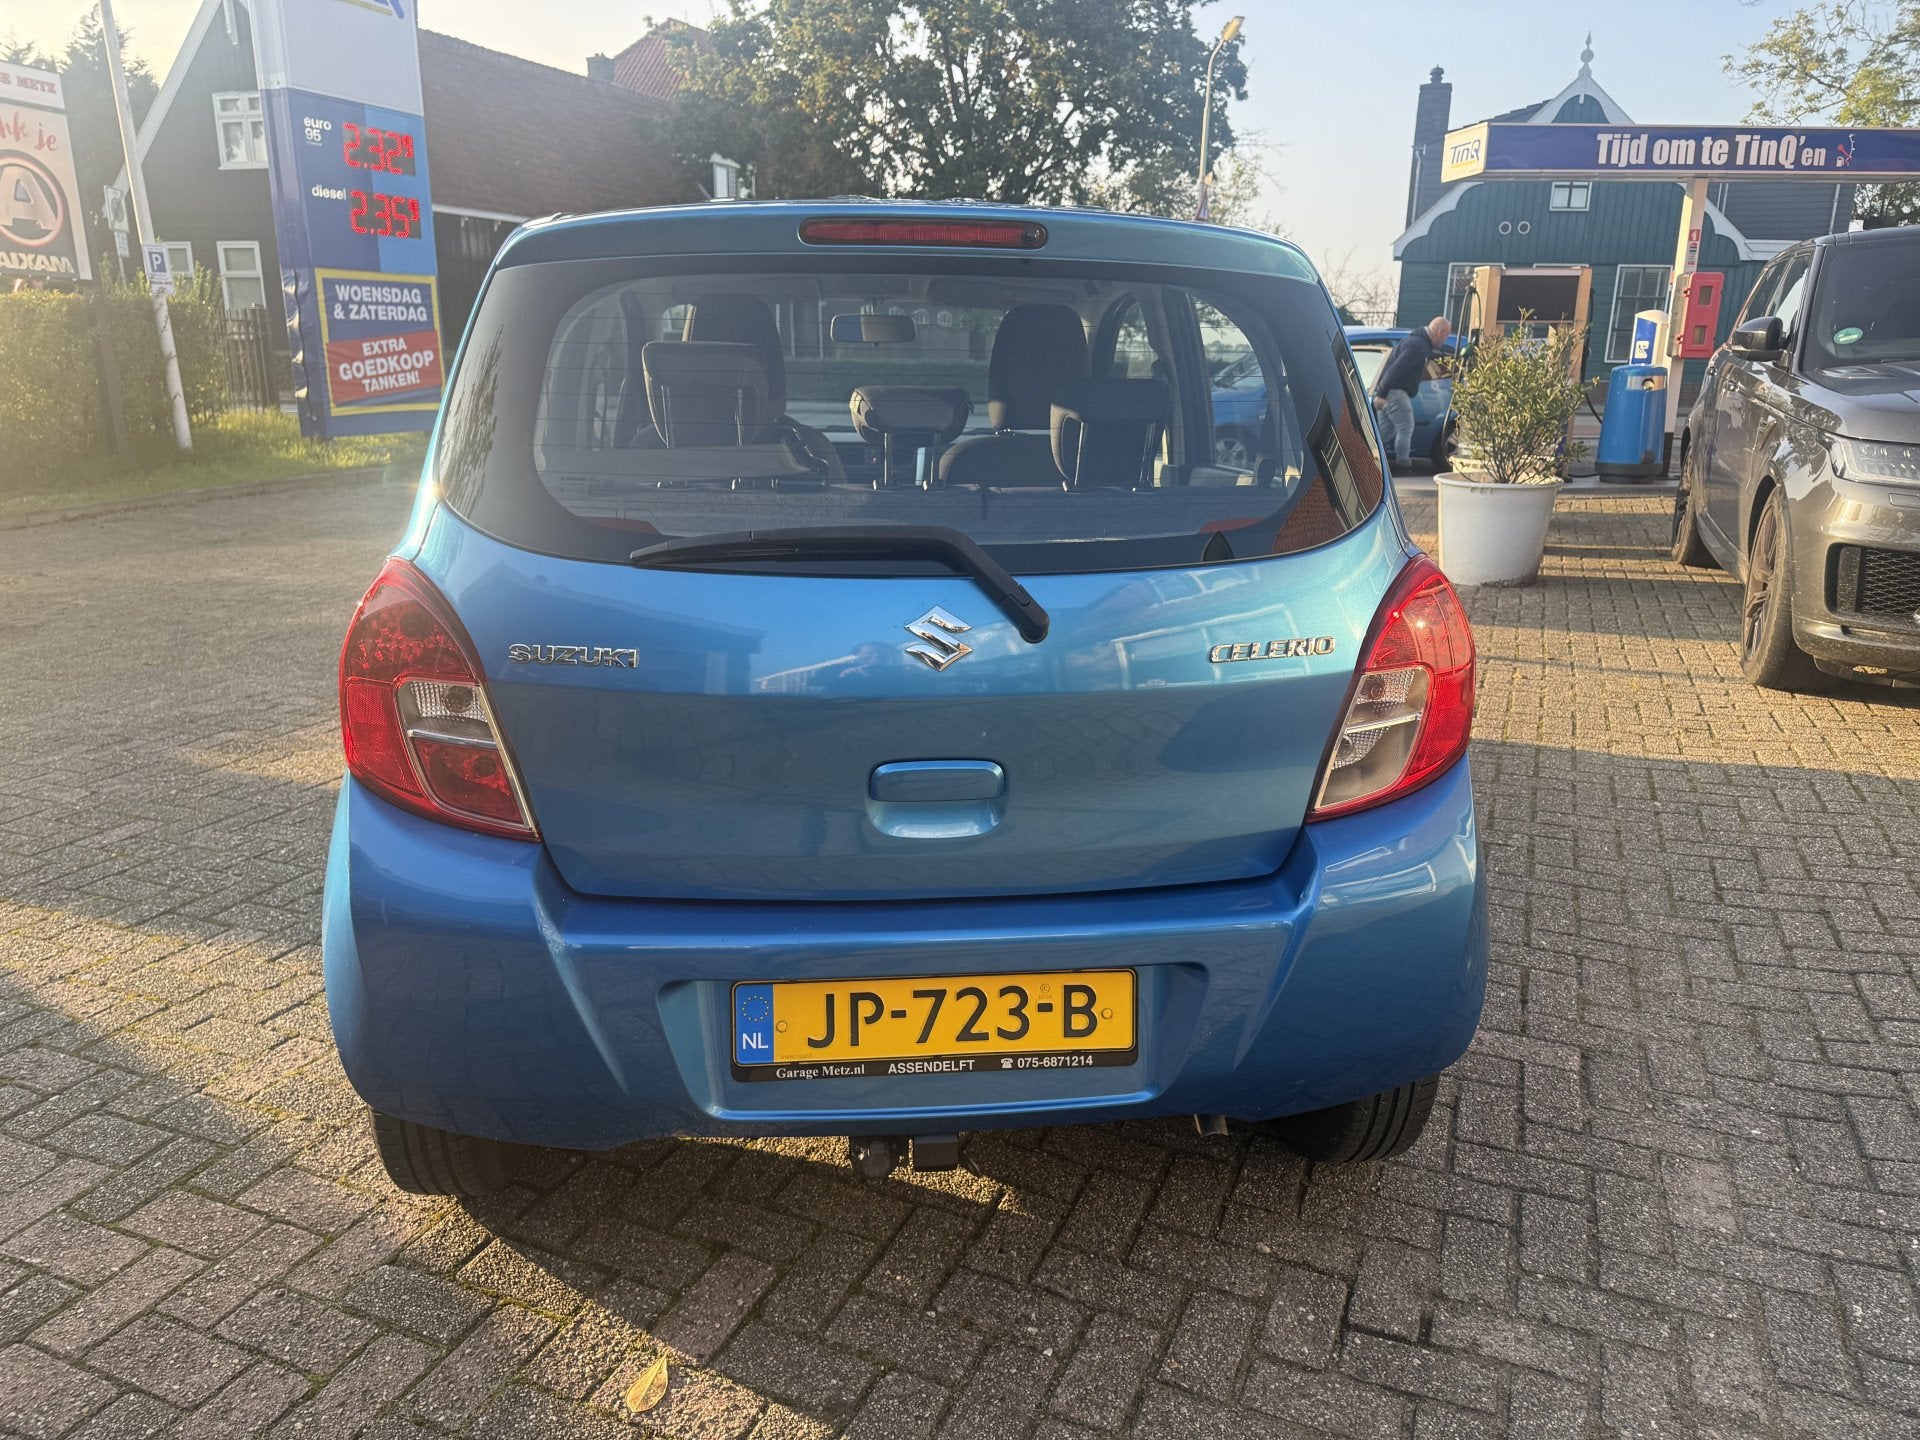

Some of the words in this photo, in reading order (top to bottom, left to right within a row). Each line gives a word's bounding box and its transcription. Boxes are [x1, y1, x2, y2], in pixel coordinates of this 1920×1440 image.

[16, 75, 57, 94] METZ
[303, 117, 332, 131] euro
[304, 127, 322, 142] 95
[1449, 139, 1481, 165] TinQ
[1597, 133, 1649, 168] Tijd
[1652, 138, 1696, 165] om
[1701, 136, 1730, 166] te
[311, 184, 347, 200] diesel
[0, 250, 75, 274] AIXAM
[151, 253, 162, 271] P
[335, 284, 422, 304] WOENSDAG
[333, 303, 345, 320] &
[349, 304, 428, 322] ZATERDAG
[362, 337, 408, 356] EXTRA
[338, 350, 435, 381] GOEDKOOP
[362, 372, 421, 393] TANKEN!
[508, 643, 639, 668] SUZUKI
[1209, 636, 1336, 663] CELERIO
[806, 984, 1098, 1049] JP-723-B
[741, 1032, 769, 1050] NL
[775, 1067, 819, 1080] Garage
[822, 1064, 866, 1077] Metz.nl
[887, 1059, 976, 1075] ASSENDELFT
[1017, 1055, 1094, 1069] 075-6871214
